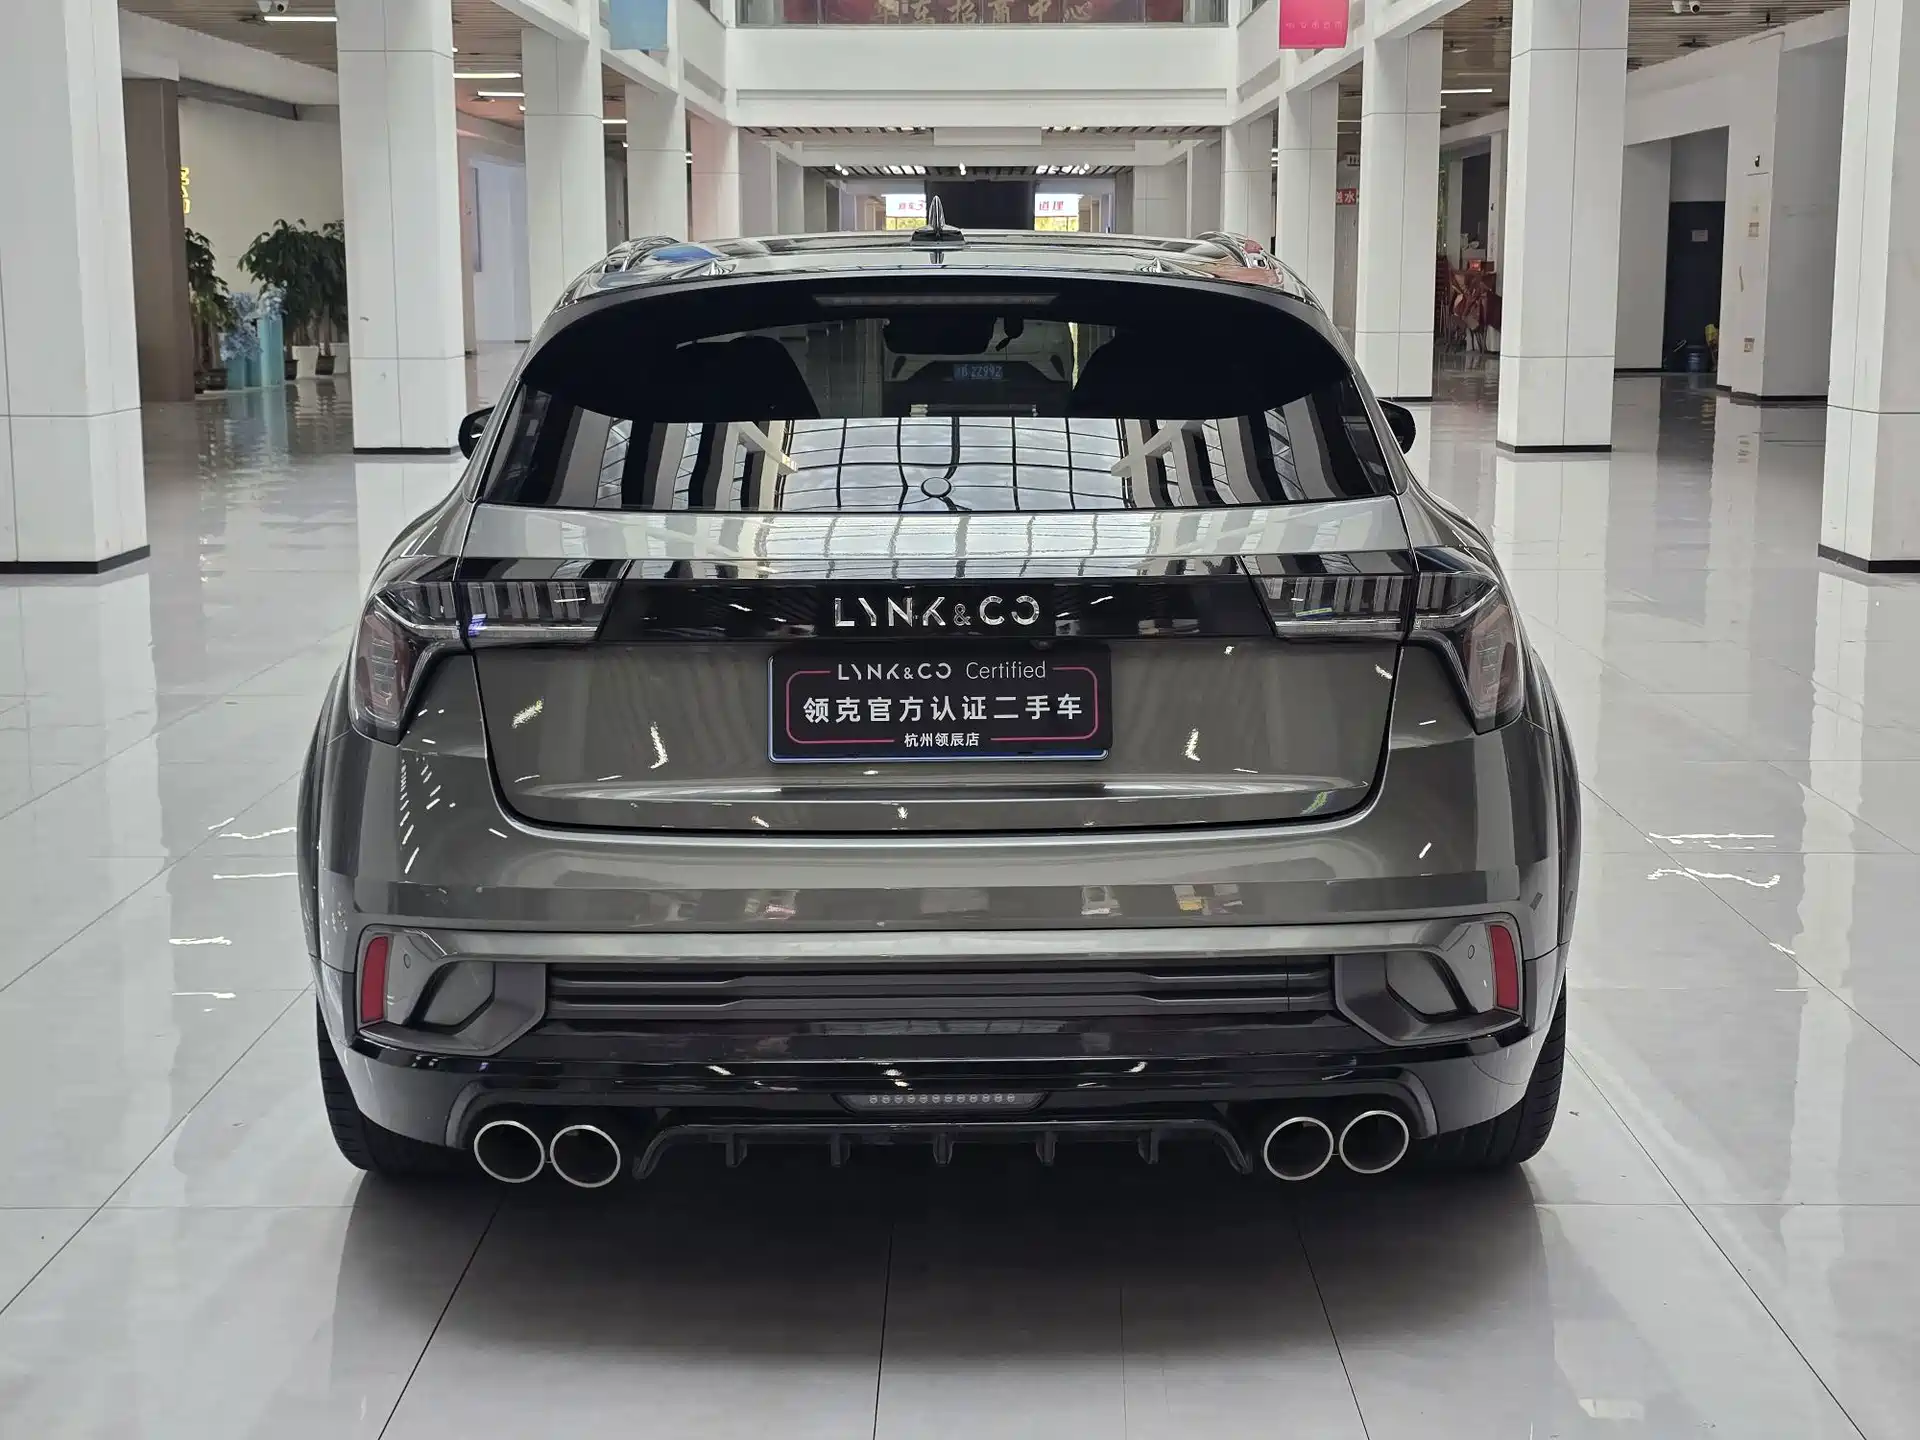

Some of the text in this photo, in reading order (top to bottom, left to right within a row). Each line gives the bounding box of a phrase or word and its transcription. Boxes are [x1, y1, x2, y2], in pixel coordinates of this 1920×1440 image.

[834, 595, 1040, 627] LYNK&CO
[838, 660, 1046, 681] LYNK&CO Certified
[803, 693, 1083, 724] 领克官方认证二手车
[904, 732, 980, 748] 杭州领辰店
